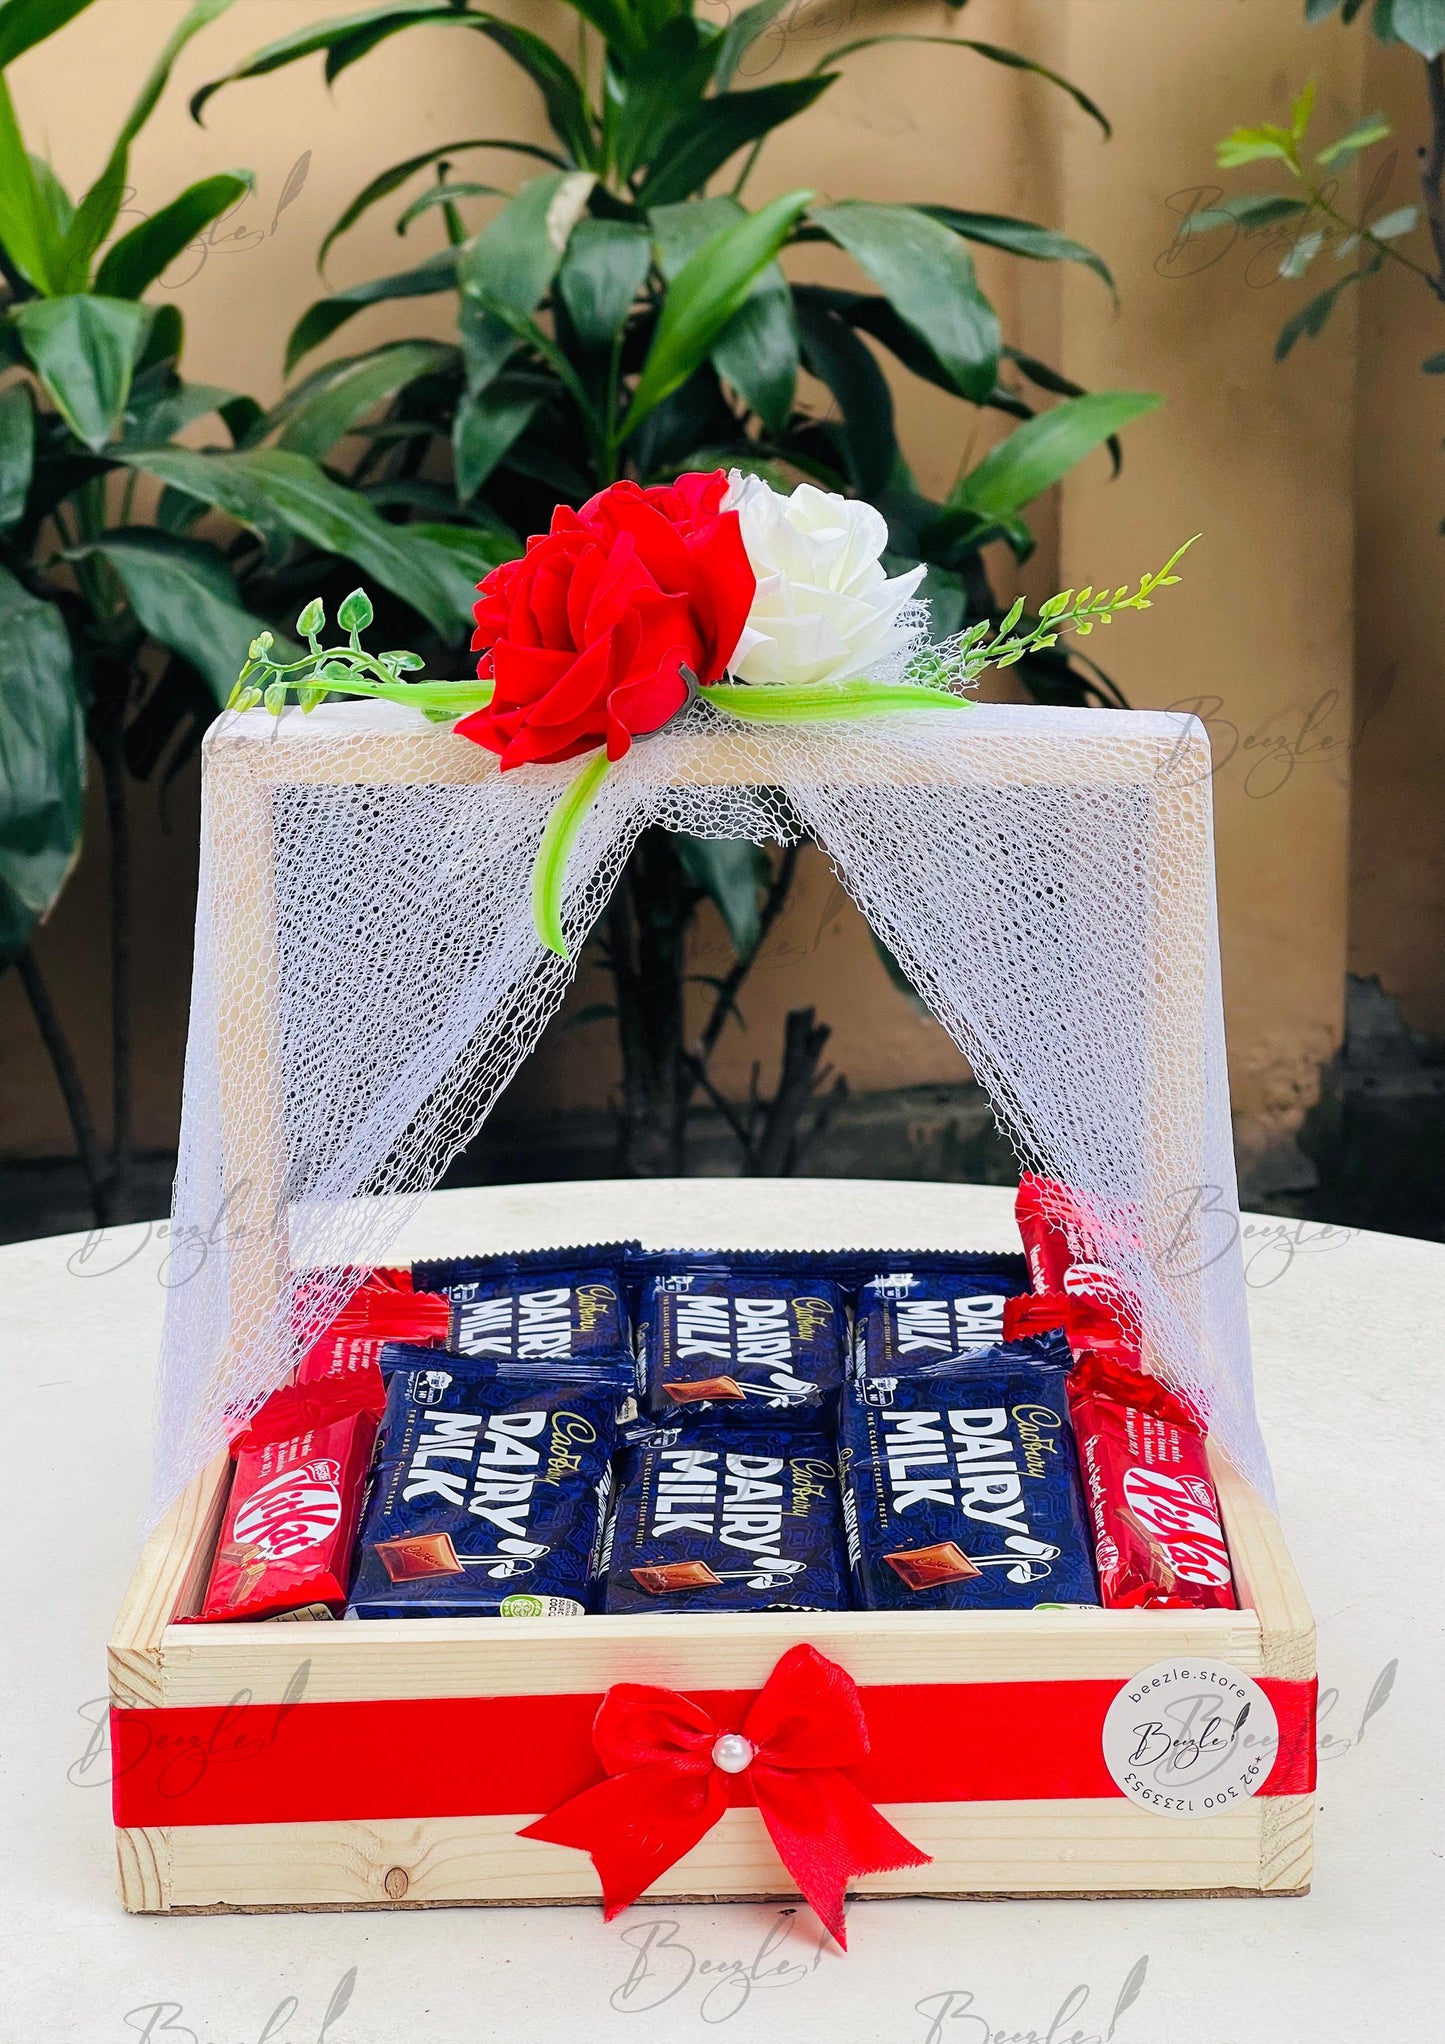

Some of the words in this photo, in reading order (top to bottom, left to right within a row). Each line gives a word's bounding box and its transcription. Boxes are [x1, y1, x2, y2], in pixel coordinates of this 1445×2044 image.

[458, 1296, 514, 1356] MILK
[675, 1294, 732, 1360] MILK
[734, 1297, 794, 1375] DAIRY
[895, 1300, 953, 1355] MILK
[953, 1294, 1007, 1348] DAI
[866, 1411, 875, 1426] THE
[1011, 1403, 1062, 1480] Cadbury
[402, 1410, 483, 1507] MILK
[467, 1410, 548, 1538] DAIRY
[547, 1410, 598, 1488] Cadbury
[881, 1410, 957, 1515] MILK
[947, 1407, 1030, 1535] DAIRY
[1084, 1435, 1103, 1463] Have
[383, 1490, 397, 1516] TASTE
[651, 1450, 719, 1538] MILK
[718, 1451, 784, 1556] DAIRY
[788, 1457, 837, 1518] Cadbury
[872, 1467, 885, 1498] CREAMY
[235, 1475, 340, 1557] KitKat
[877, 1502, 889, 1529] TASTE
[1092, 1505, 1106, 1529] have
[1124, 1470, 1231, 1586] KitKat
[1128, 1668, 1247, 1704] beezle.store
[1123, 1772, 1195, 1812] 1233953
[1203, 1786, 1240, 1810] 300
[1240, 1755, 1265, 1785] +92
